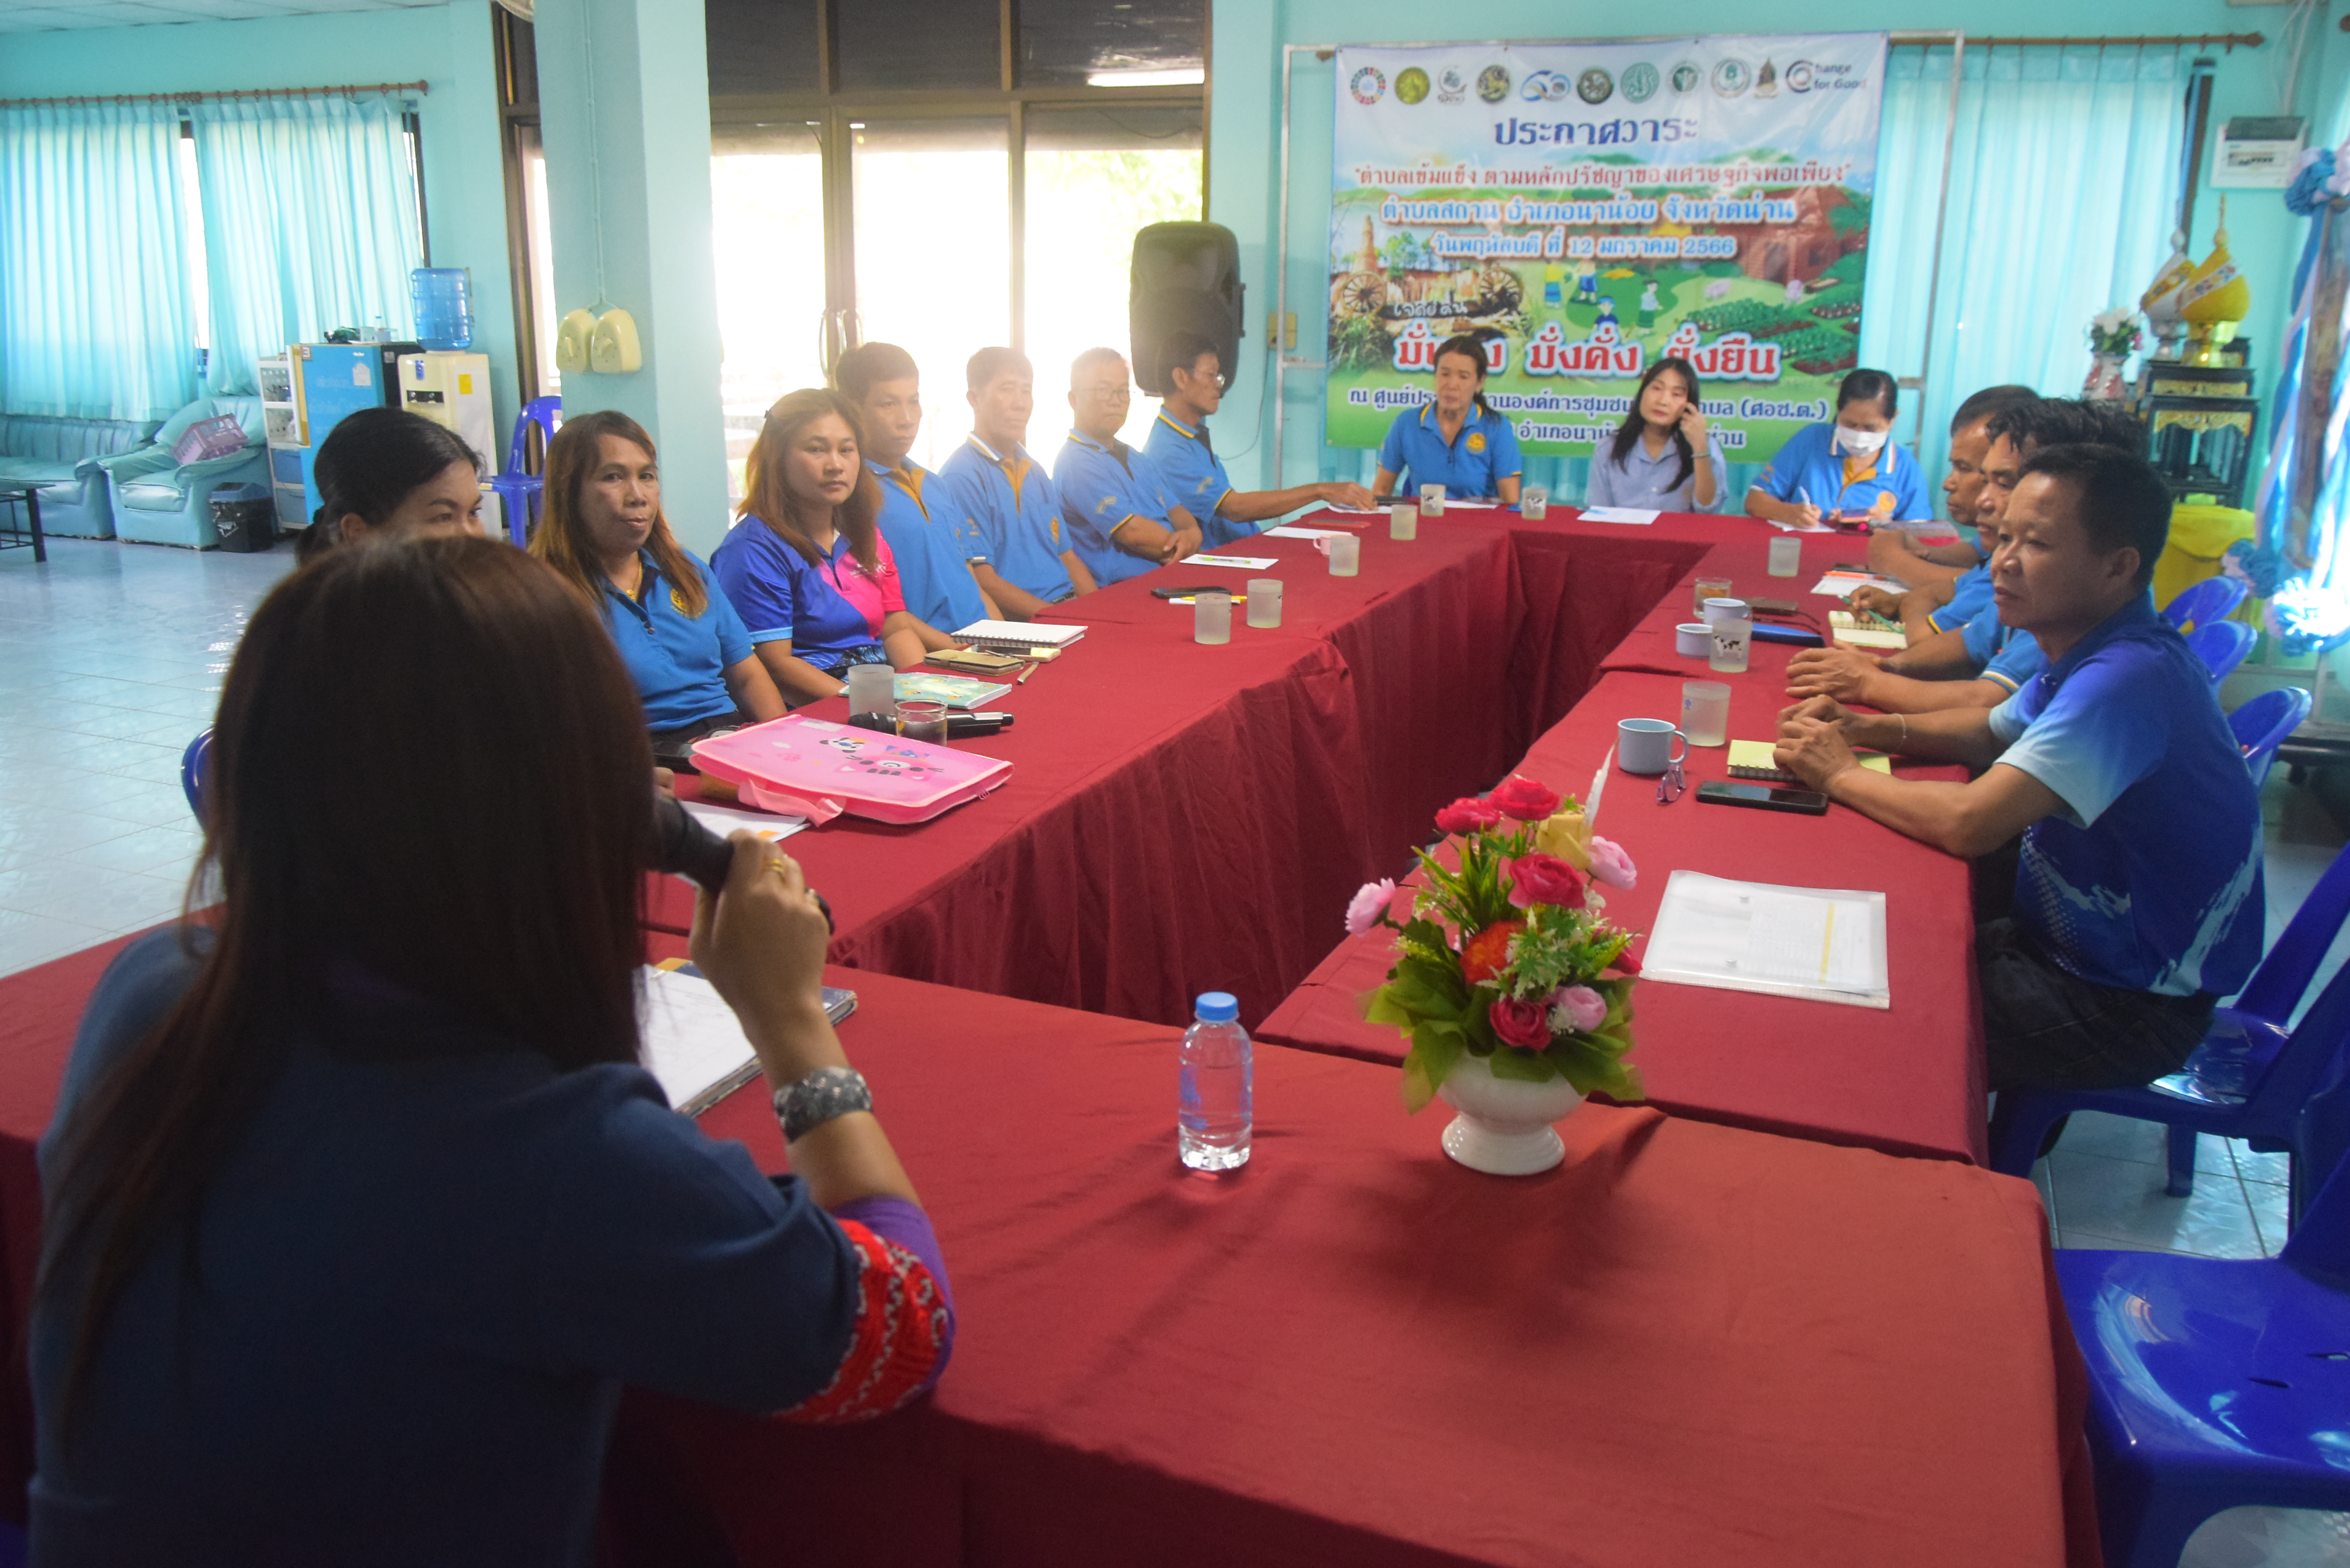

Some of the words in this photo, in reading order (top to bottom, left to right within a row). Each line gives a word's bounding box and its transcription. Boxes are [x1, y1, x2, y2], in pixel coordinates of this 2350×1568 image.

[1494, 118, 1698, 145] ประกาศวาระ
[1383, 195, 1498, 220] ตำบลสถาน
[1508, 193, 1656, 220] อำเภอนาน้อย
[1663, 190, 1794, 220] จังหวัดน่าน
[1434, 231, 1541, 255] วันพฤหัสบดี
[1571, 240, 1592, 253] 12
[1600, 239, 1676, 253] มกราคม
[1685, 239, 1735, 253] 2566
[1529, 326, 1638, 371] มั่งคั่ง
[1350, 390, 1367, 403] ณ
